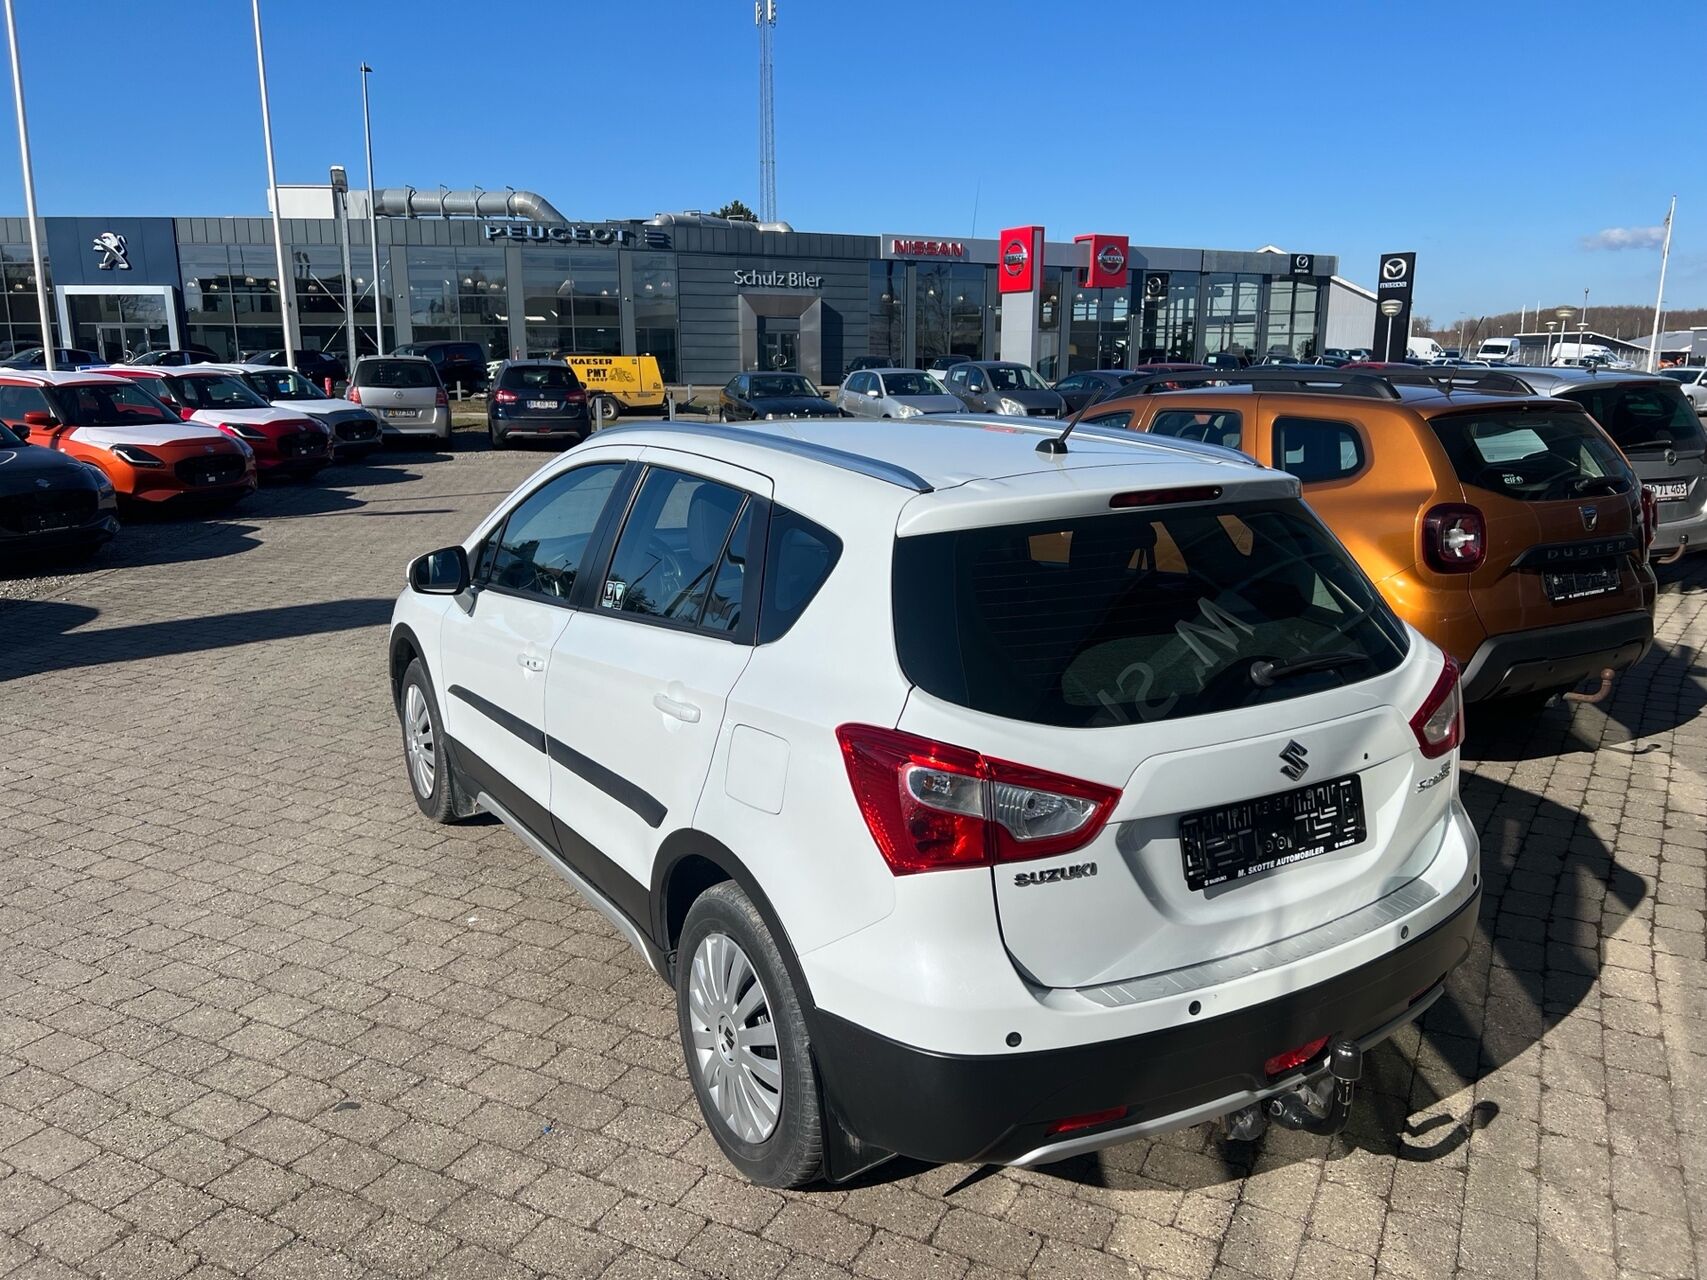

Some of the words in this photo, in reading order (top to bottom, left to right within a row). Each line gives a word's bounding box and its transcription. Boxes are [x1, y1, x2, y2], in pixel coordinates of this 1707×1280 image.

[485, 224, 625, 243] PEUGEOT
[892, 239, 964, 257] NISSAN
[734, 269, 785, 285] Schulz
[788, 271, 821, 287] Biler
[587, 368, 607, 377] PMT
[1659, 484, 1668, 495] 71
[1547, 541, 1626, 559] DUSTER
[1237, 869, 1247, 878] M.
[1248, 860, 1275, 875] SKOTTE
[1276, 846, 1325, 867] AUTOMOBILER
[1014, 862, 1098, 888] SUZUKI
